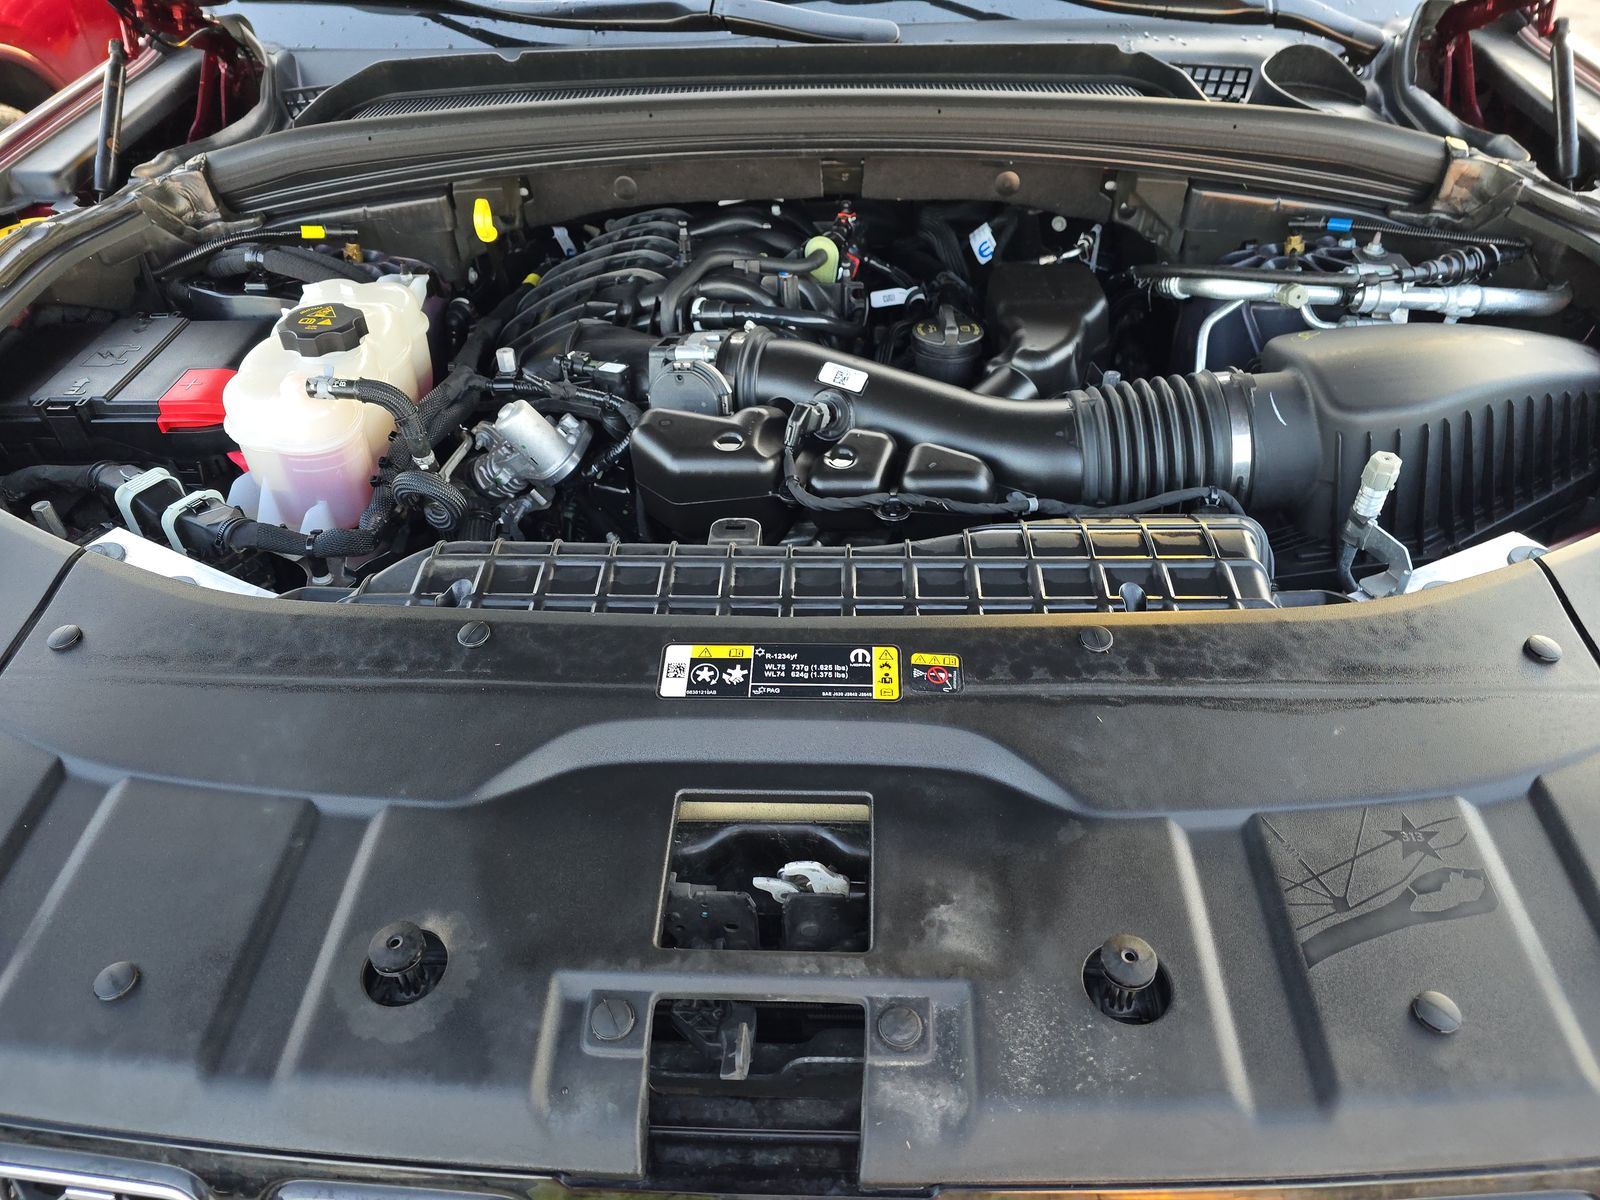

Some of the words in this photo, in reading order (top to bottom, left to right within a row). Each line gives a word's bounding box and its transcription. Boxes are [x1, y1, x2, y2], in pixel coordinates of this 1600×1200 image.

[791, 671, 809, 679] 624g
[810, 671, 833, 679] (1.375
[834, 671, 849, 679] lbs)
